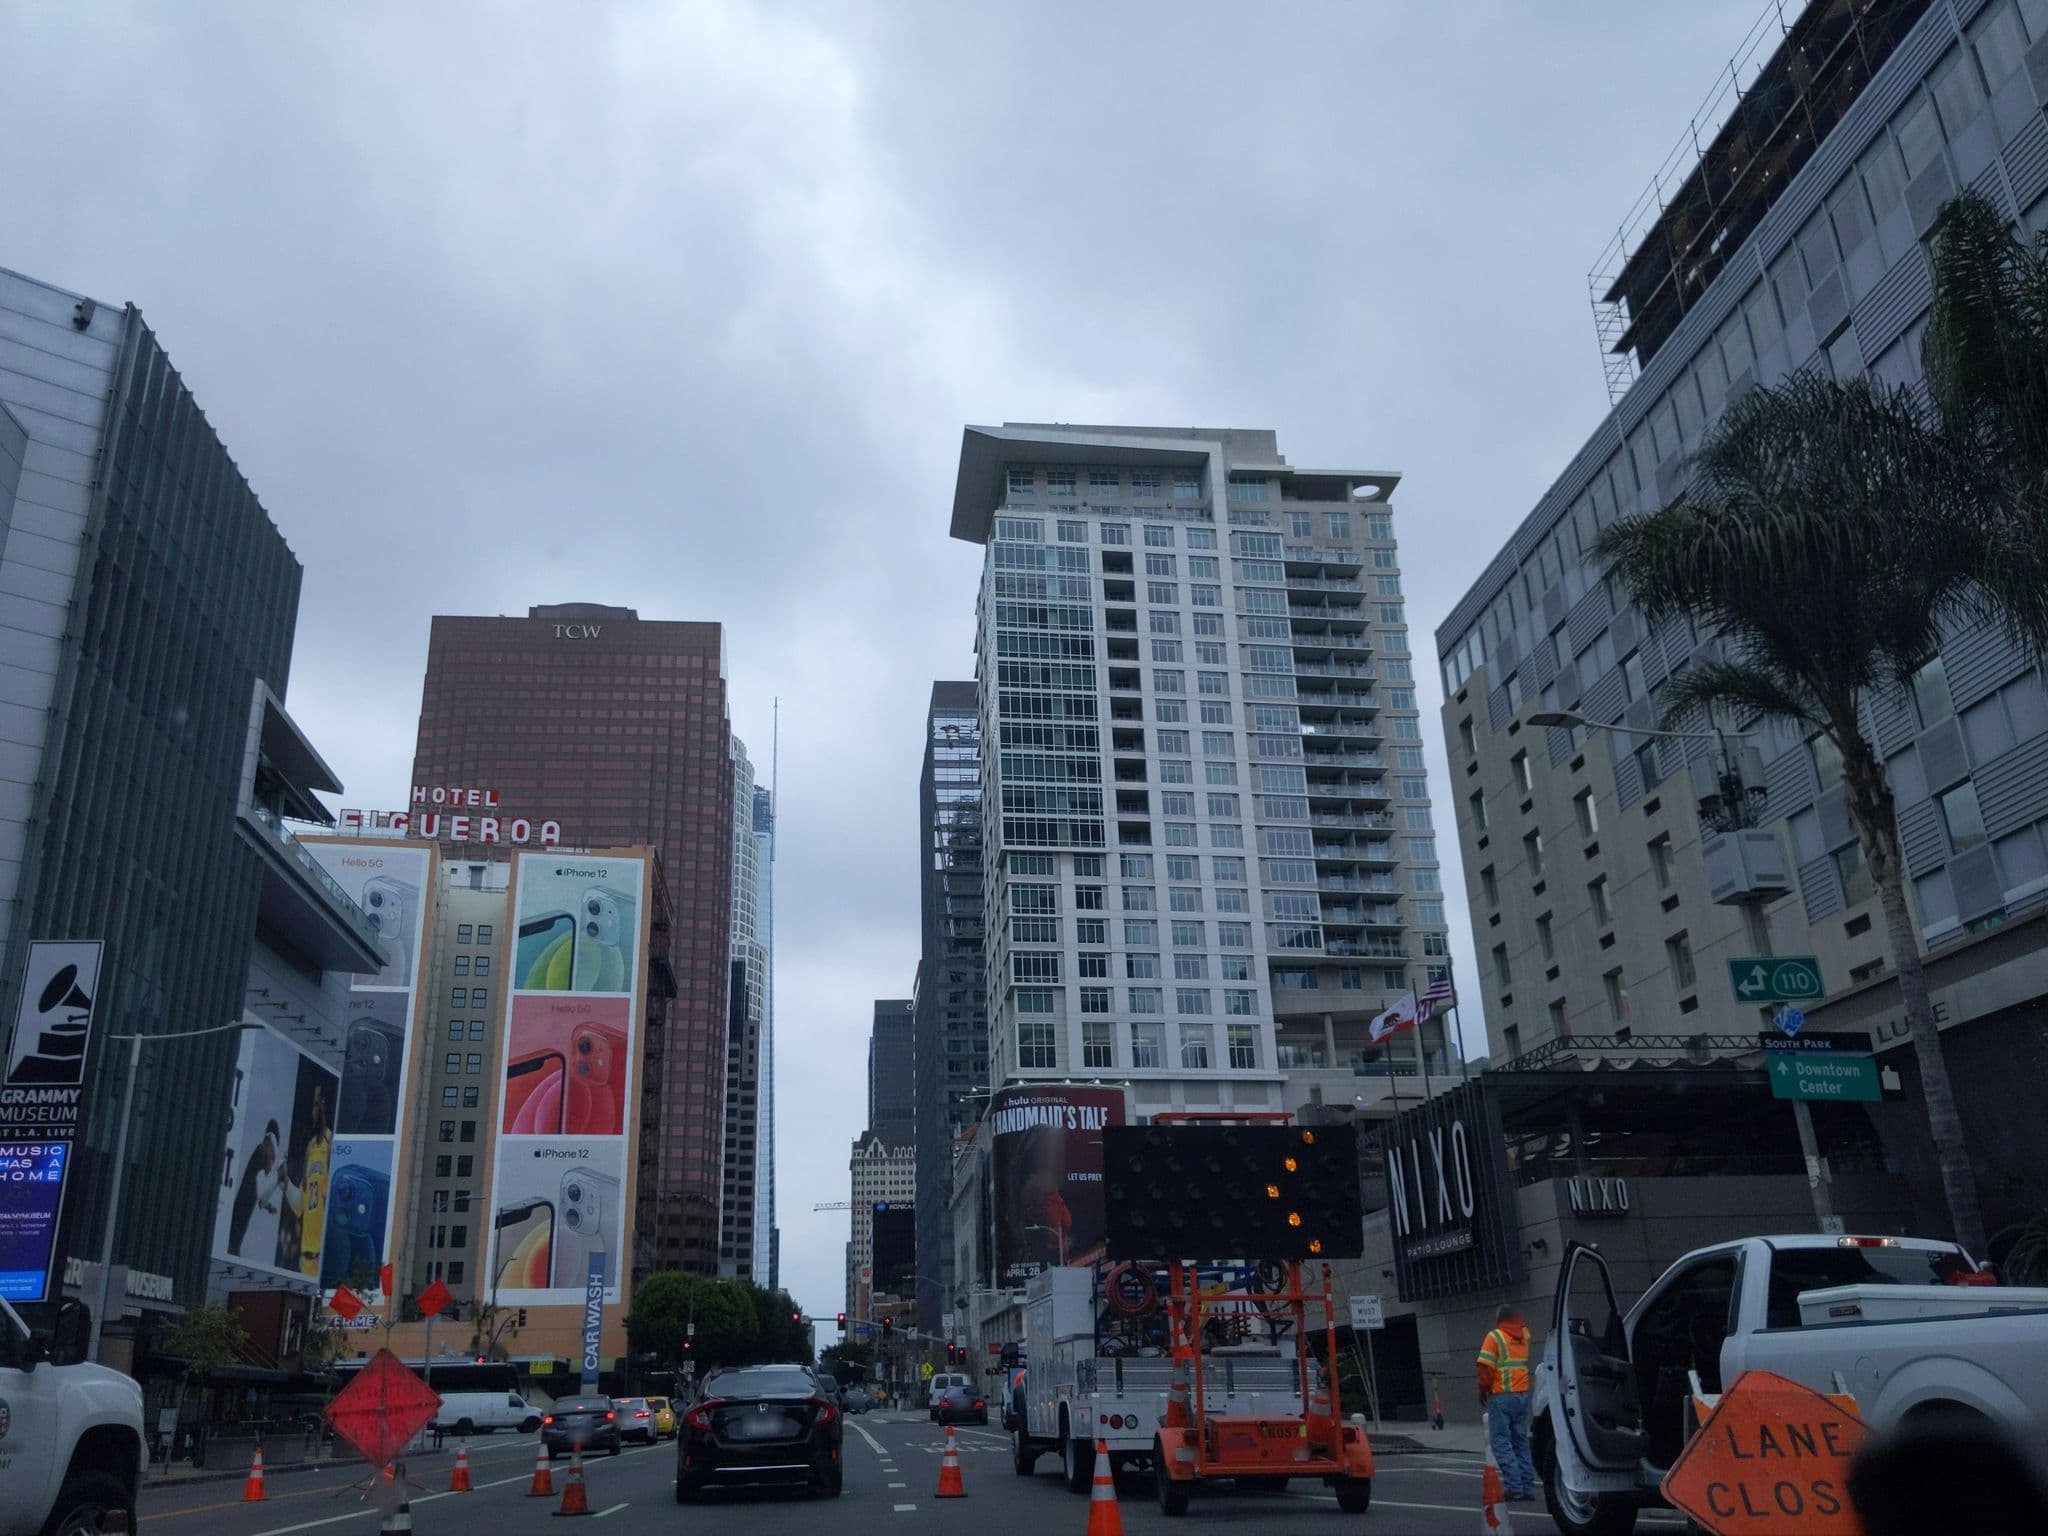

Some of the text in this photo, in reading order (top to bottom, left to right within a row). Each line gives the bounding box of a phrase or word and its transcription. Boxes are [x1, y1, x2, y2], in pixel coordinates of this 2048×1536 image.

[552, 624, 601, 639] TCW
[413, 786, 498, 807] HOTEL
[340, 809, 561, 844] FIGUEROA
[342, 858, 384, 869] Hello 5G
[563, 868, 608, 878] iPhone 12
[1781, 972, 1810, 990] 110
[1876, 1001, 1950, 1043] LUE
[1796, 1061, 1861, 1078] Downtown
[1799, 1079, 1842, 1095] Center
[1, 1088, 80, 1104] GRAMMY
[1008, 1096, 1029, 1107] hulu
[1031, 1096, 1068, 1105] ORIGINAL
[0, 1106, 78, 1121] MUSEUM
[996, 1105, 1077, 1135] HANDMAID'S
[0, 1128, 75, 1137] T L.A. LIVE
[0, 1146, 62, 1157] MUSIC
[542, 1149, 589, 1158] iPhone 12
[49, 1158, 60, 1168] A
[1067, 1173, 1078, 1181] LET
[1388, 1121, 1474, 1238] NIXO
[1568, 1178, 1629, 1210] NIXO
[1407, 1233, 1472, 1256] PATIO LOUNGE
[1006, 1268, 1027, 1278] APRIL
[127, 1269, 173, 1301] MUSEUM
[584, 1273, 603, 1370] CAR WASH
[1725, 1422, 1851, 1458] LANE
[1706, 1480, 1850, 1518] CLOS
